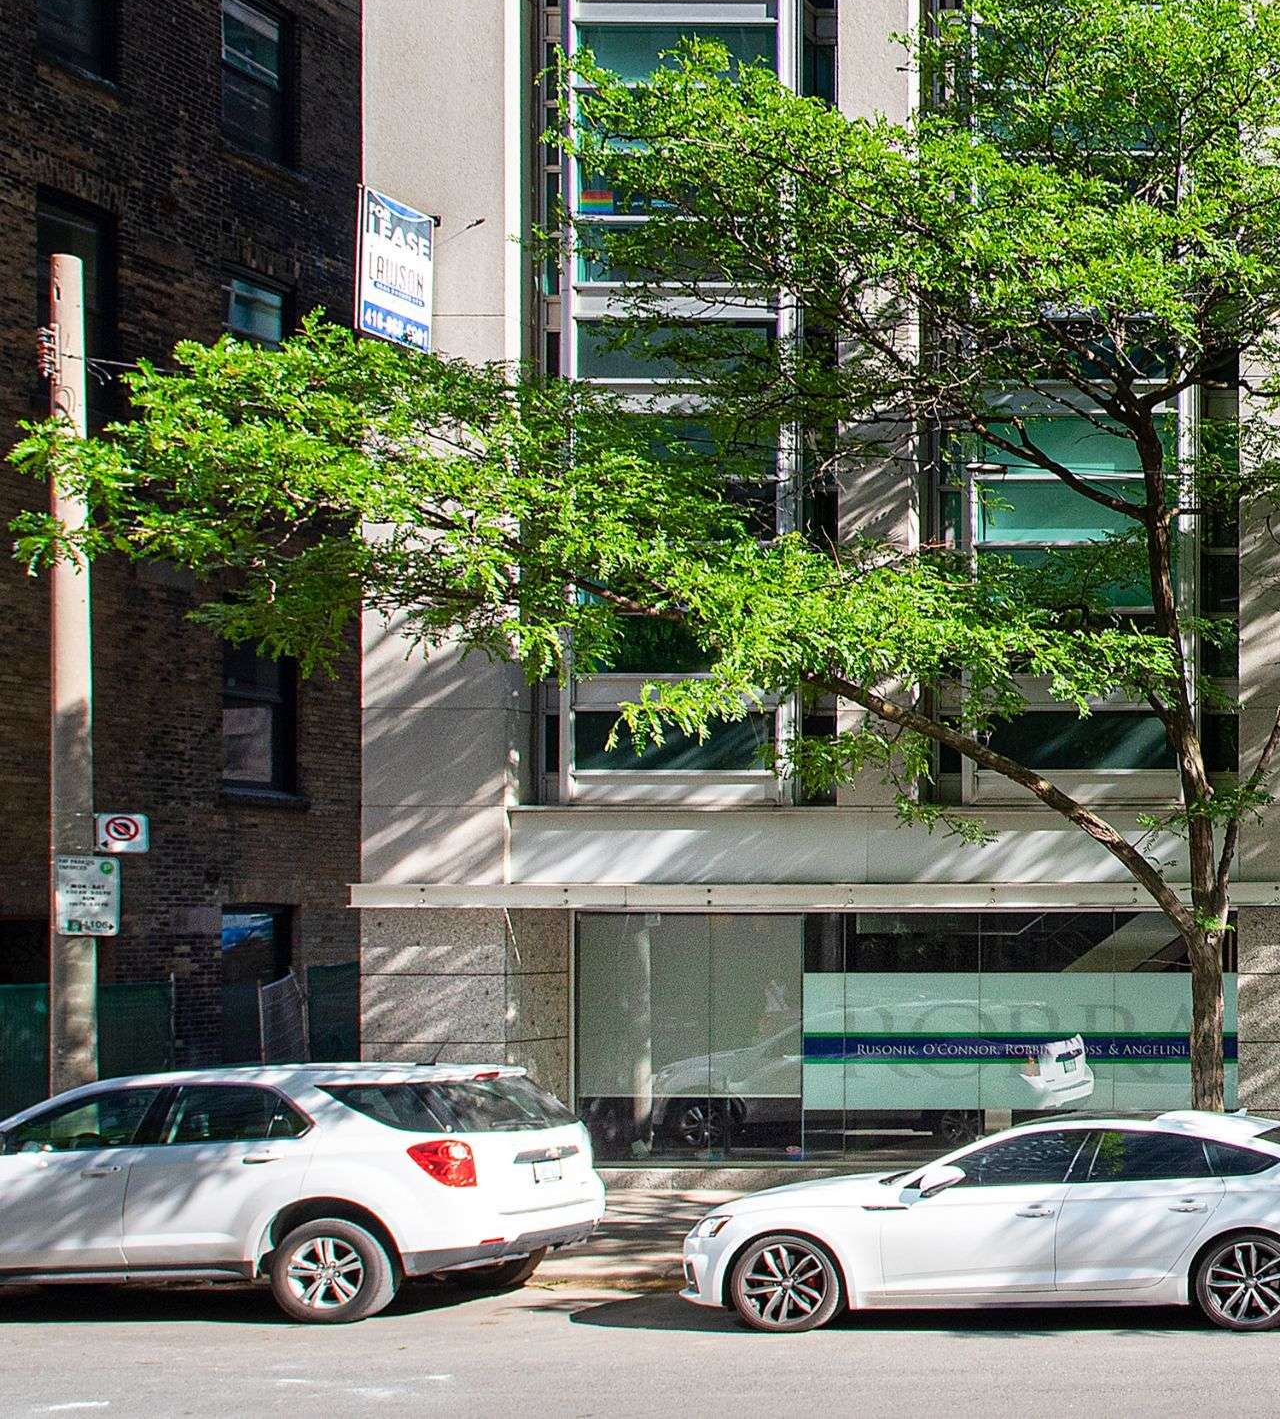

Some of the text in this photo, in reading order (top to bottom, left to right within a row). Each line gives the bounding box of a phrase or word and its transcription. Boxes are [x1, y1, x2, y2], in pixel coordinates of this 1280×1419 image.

[369, 201, 391, 221] FOR
[367, 214, 431, 261] LEASE
[369, 252, 424, 297] LAWSON
[1108, 1042, 1119, 1056] &
